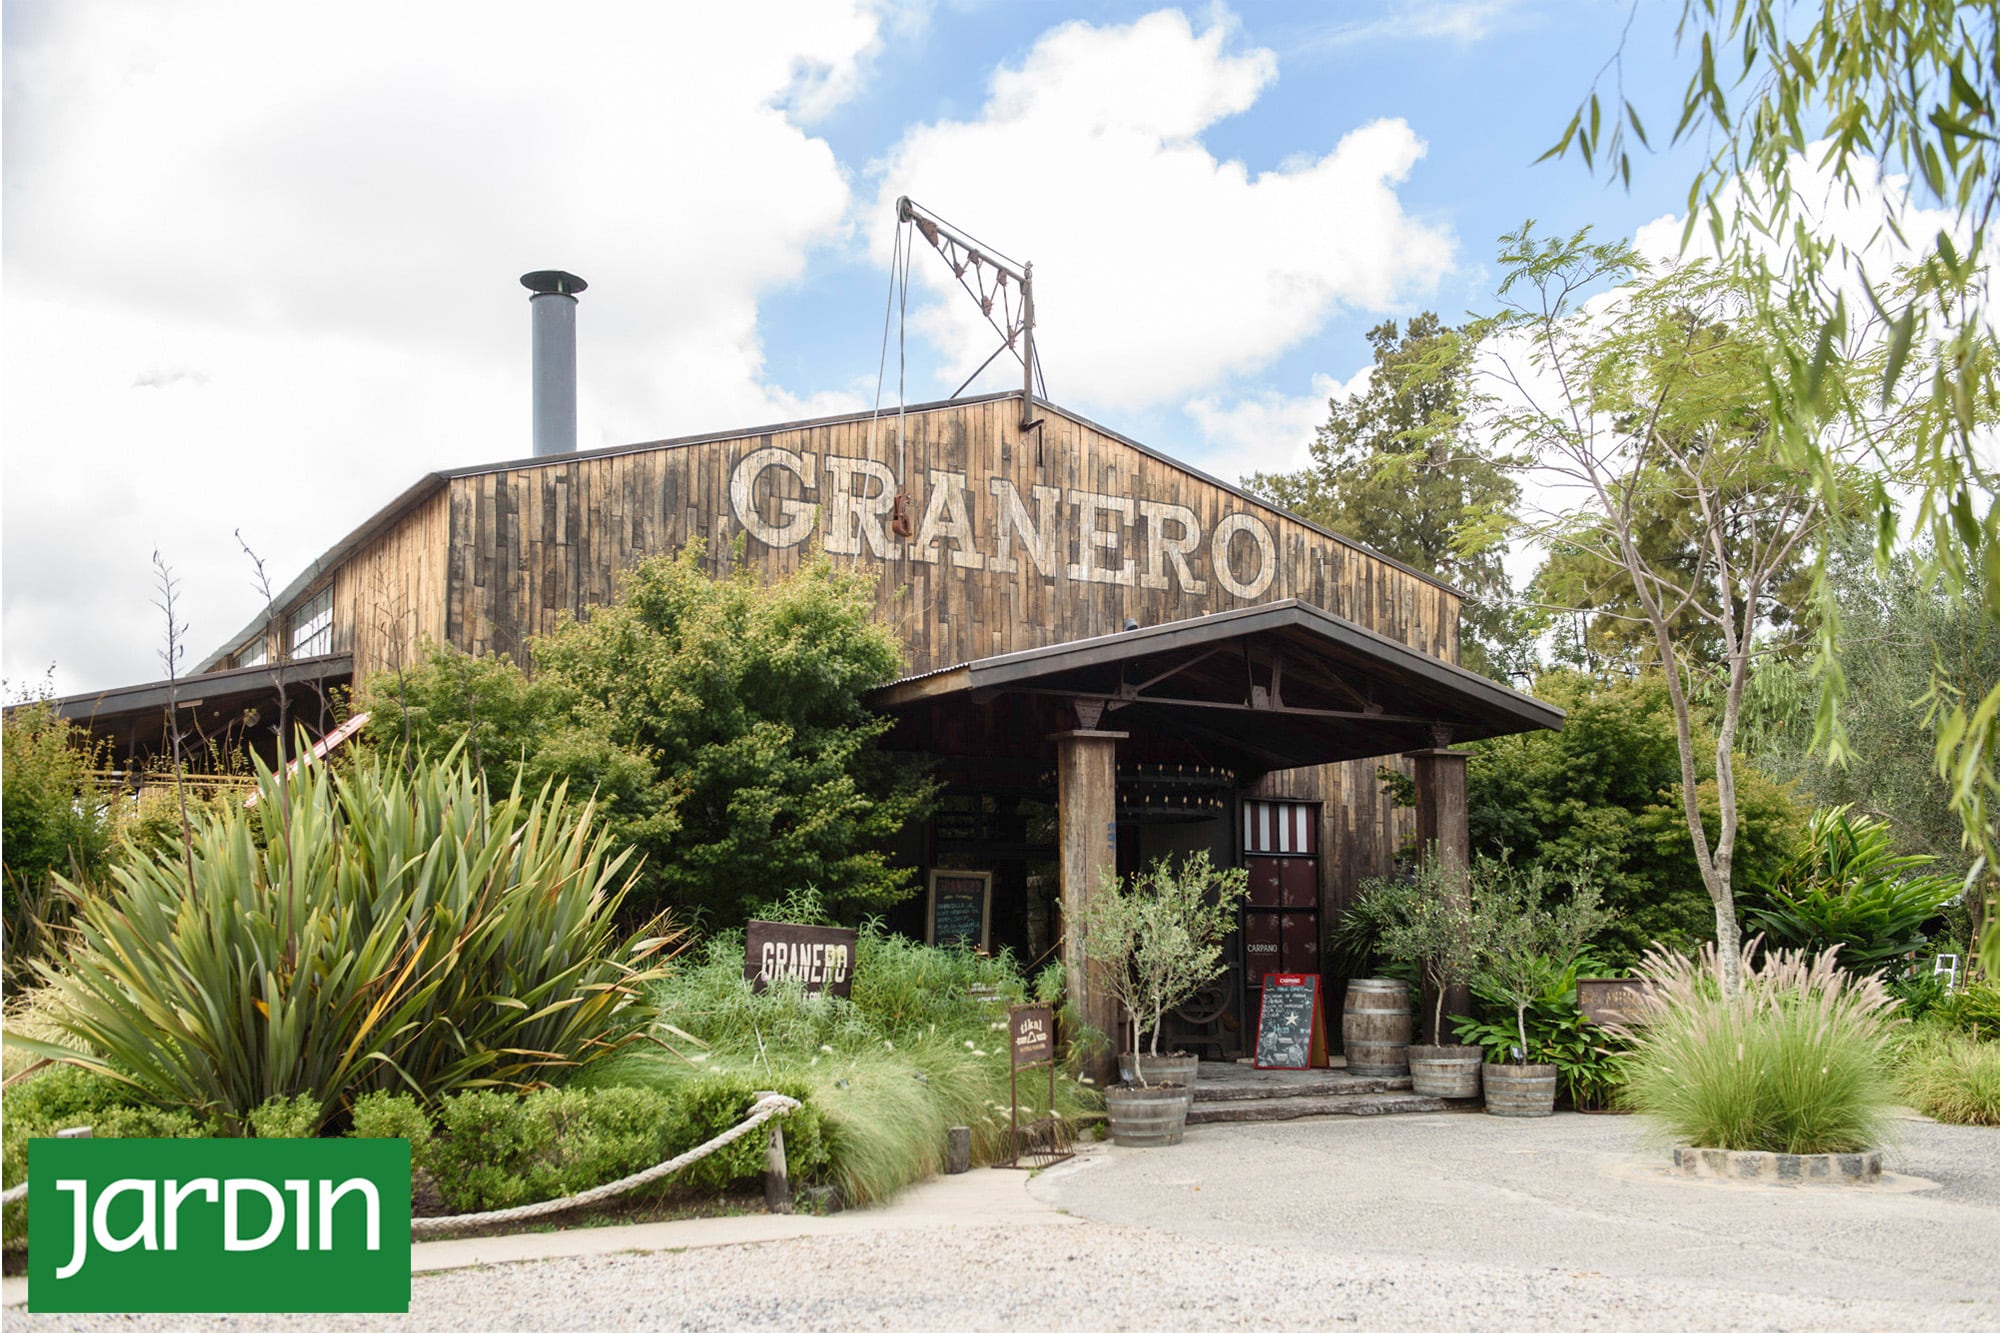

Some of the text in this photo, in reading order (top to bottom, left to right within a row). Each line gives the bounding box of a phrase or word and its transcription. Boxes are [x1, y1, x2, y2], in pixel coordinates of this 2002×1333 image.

[729, 447, 1277, 600] GRANERO
[761, 941, 848, 983] GRANERO
[1247, 943, 1278, 953] CARPANO
